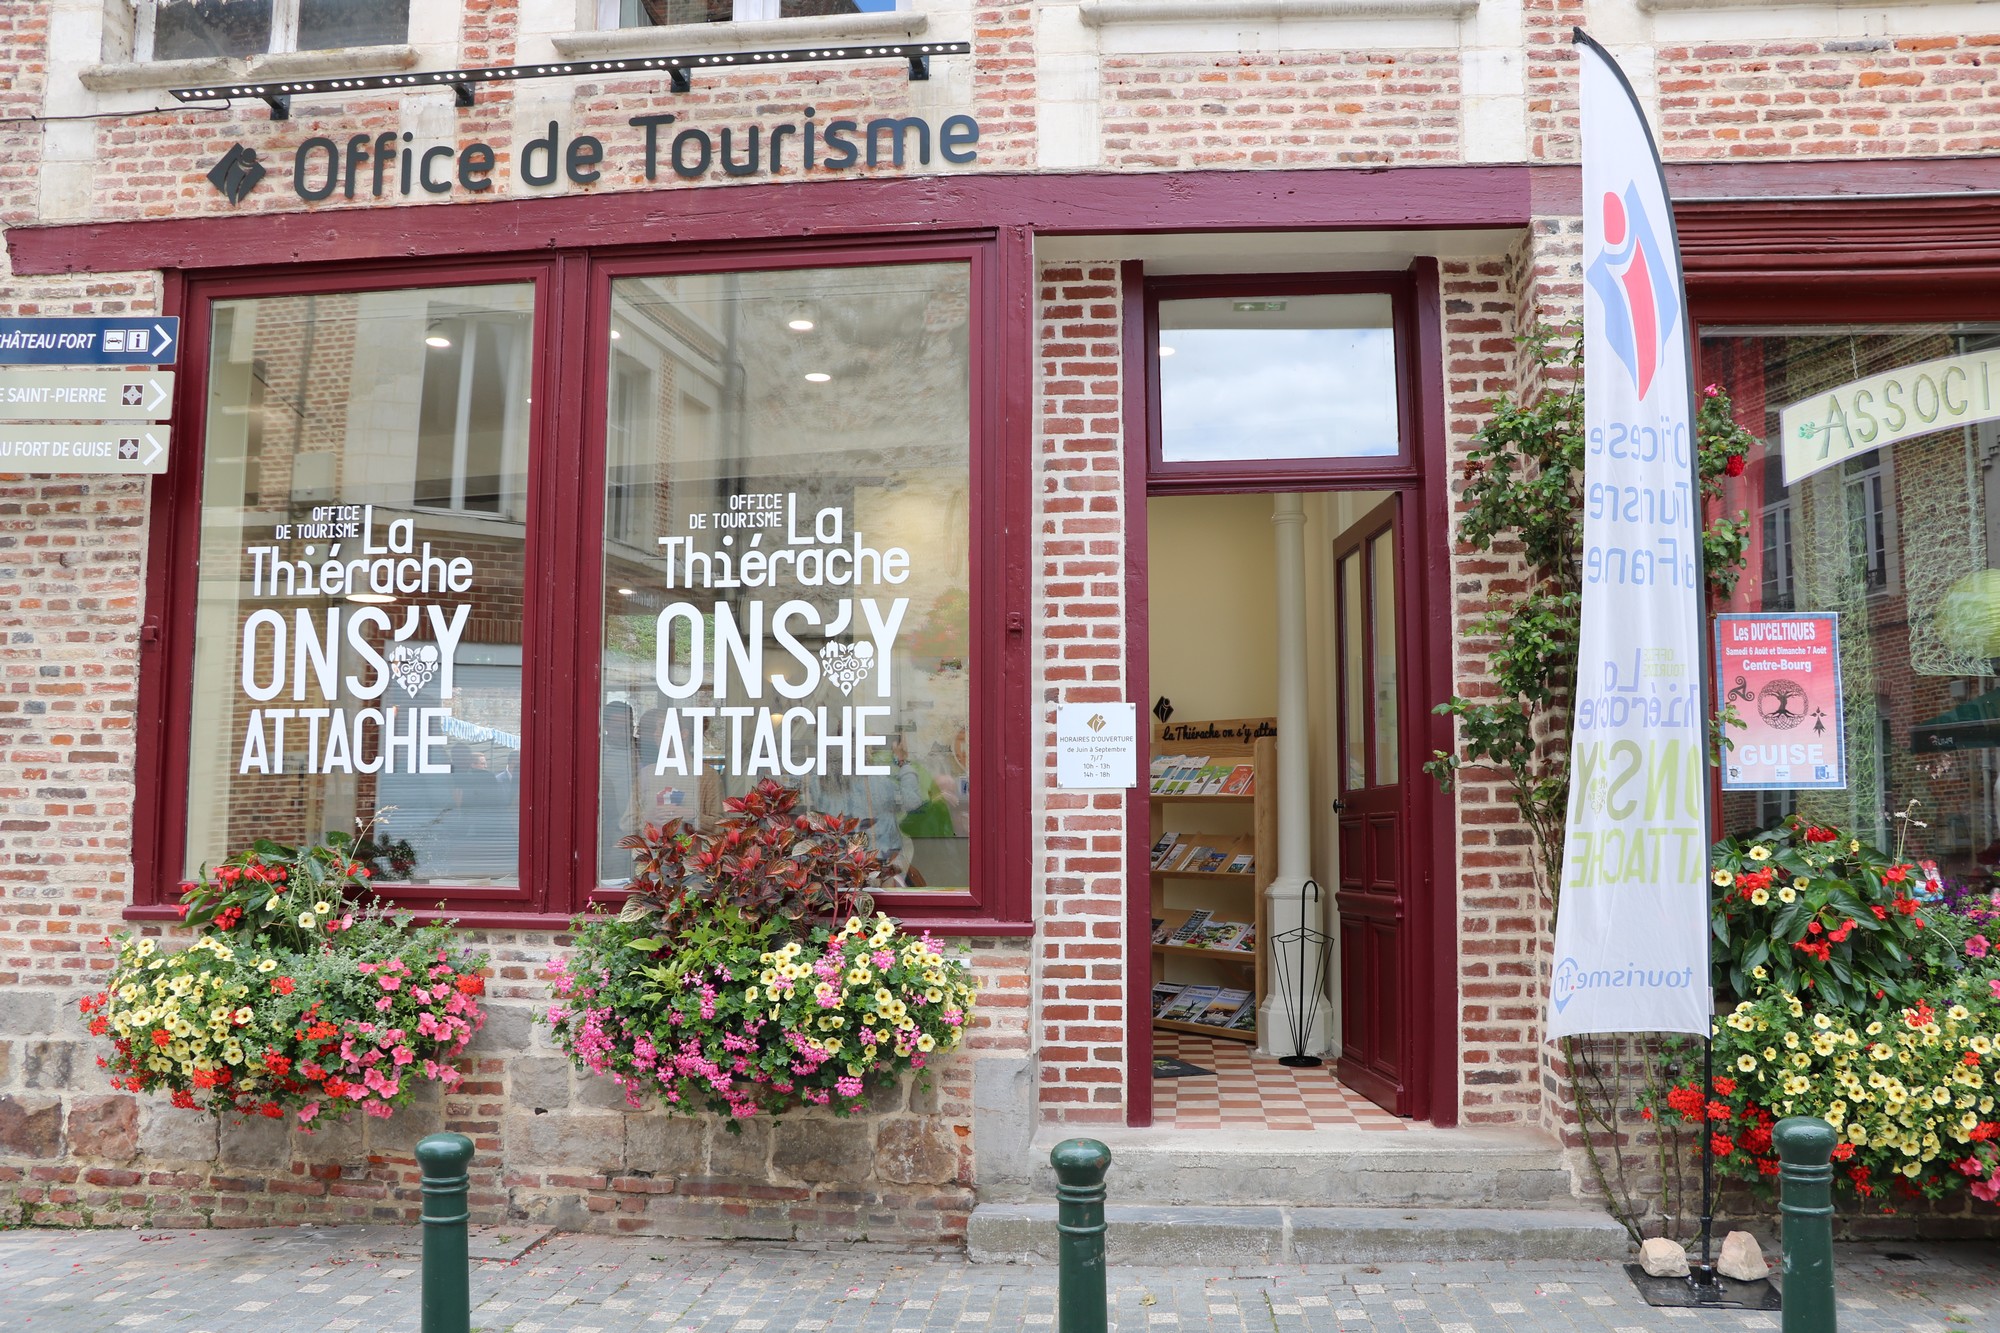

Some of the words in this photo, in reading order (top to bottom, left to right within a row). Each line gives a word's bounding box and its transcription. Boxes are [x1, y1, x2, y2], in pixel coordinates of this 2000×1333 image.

[294, 131, 495, 201] Office
[520, 120, 603, 188] de
[628, 107, 980, 180] Tourisme
[0, 330, 56, 349] HÂTEAU
[57, 333, 97, 349] FORT
[7, 387, 107, 403] SAINT-PIERRE
[1812, 361, 1990, 461] ASSOCI
[14, 441, 50, 457] FORT
[53, 441, 70, 457] DE
[72, 441, 113, 457] GUISE
[729, 493, 783, 510] OFFICE
[312, 505, 360, 521] OFFICE
[689, 513, 707, 529] DE
[713, 512, 783, 529] TOURISME
[787, 492, 843, 545] La
[275, 525, 291, 540] DE
[297, 522, 359, 539] TOURISME
[363, 504, 414, 554] La
[247, 542, 473, 596] Thiérache
[658, 531, 910, 589] Thiérache
[1733, 623, 1749, 641] Les
[1751, 622, 1815, 641] DU'CELTIQUES
[1725, 647, 1748, 656] Samedi
[1749, 647, 1754, 655] 6
[1769, 647, 1776, 655] et
[1777, 646, 1806, 655] Dimanche
[1807, 646, 1811, 655] 7
[1742, 659, 1812, 672] Centre-Bourg
[239, 707, 453, 774] ATTACHE
[654, 706, 891, 776] ATTACHE
[1091, 735, 1134, 743] D'OUVERTURE
[1175, 722, 1221, 741] Thiérache
[1222, 728, 1234, 738] on
[1236, 723, 1251, 744] s'y
[1739, 744, 1824, 766] GUISE
